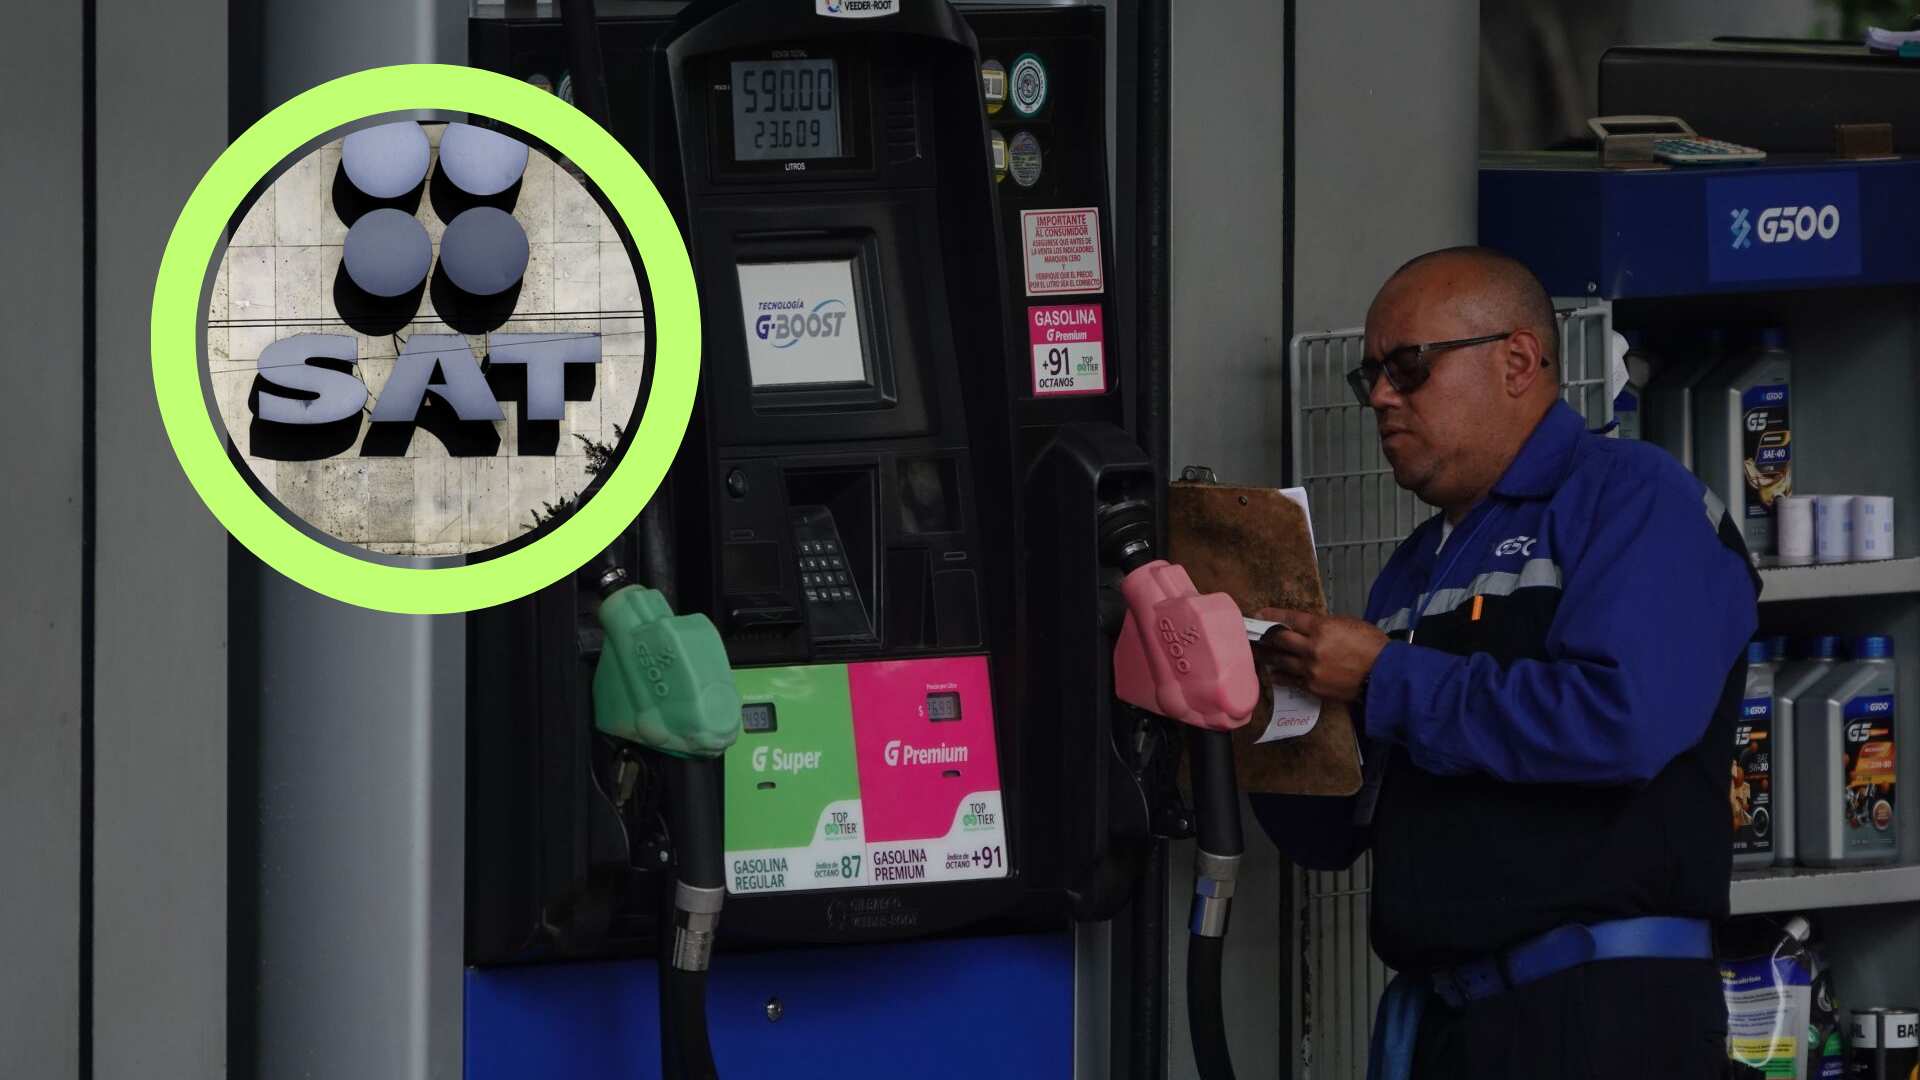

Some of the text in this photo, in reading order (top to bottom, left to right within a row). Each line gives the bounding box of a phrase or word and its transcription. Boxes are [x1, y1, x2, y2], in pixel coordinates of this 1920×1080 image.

[743, 68, 832, 113] 590.00
[754, 119, 821, 149] 23.609
[785, 162, 806, 171] LITROS
[1036, 214, 1087, 227] IMPORTANTE
[1757, 204, 1840, 243] G500
[1036, 226, 1089, 238] AL CONSUMIDOR
[1038, 247, 1052, 255] VENTA
[1044, 254, 1081, 263] MARQUEN CERO
[758, 298, 805, 310] TECNOLOGÍA
[1035, 309, 1097, 326] GASOLINA
[1046, 329, 1087, 341] G Premium
[1042, 347, 1070, 376] +91
[1081, 356, 1093, 364] TOP
[256, 331, 602, 424] SAT
[1039, 377, 1074, 388] OCTANOS
[1747, 412, 1769, 431] G5
[1159, 616, 1192, 674] G500
[1276, 715, 1310, 727] Getnet
[1848, 723, 1872, 742] G5
[752, 746, 822, 775] G Super
[884, 740, 969, 766] G Premium
[969, 803, 986, 814] TOP
[831, 812, 848, 823] TOP
[976, 814, 995, 825] TIER
[840, 823, 856, 835] TIER
[873, 848, 927, 866] GASOLINA
[945, 860, 971, 870] OCTANO
[971, 846, 1002, 870] +91
[734, 857, 789, 875] GASOLINA
[814, 868, 840, 879] OCTANO
[841, 855, 861, 879] 87
[875, 865, 925, 881] PREMIUM
[735, 874, 785, 891] REGULAR
